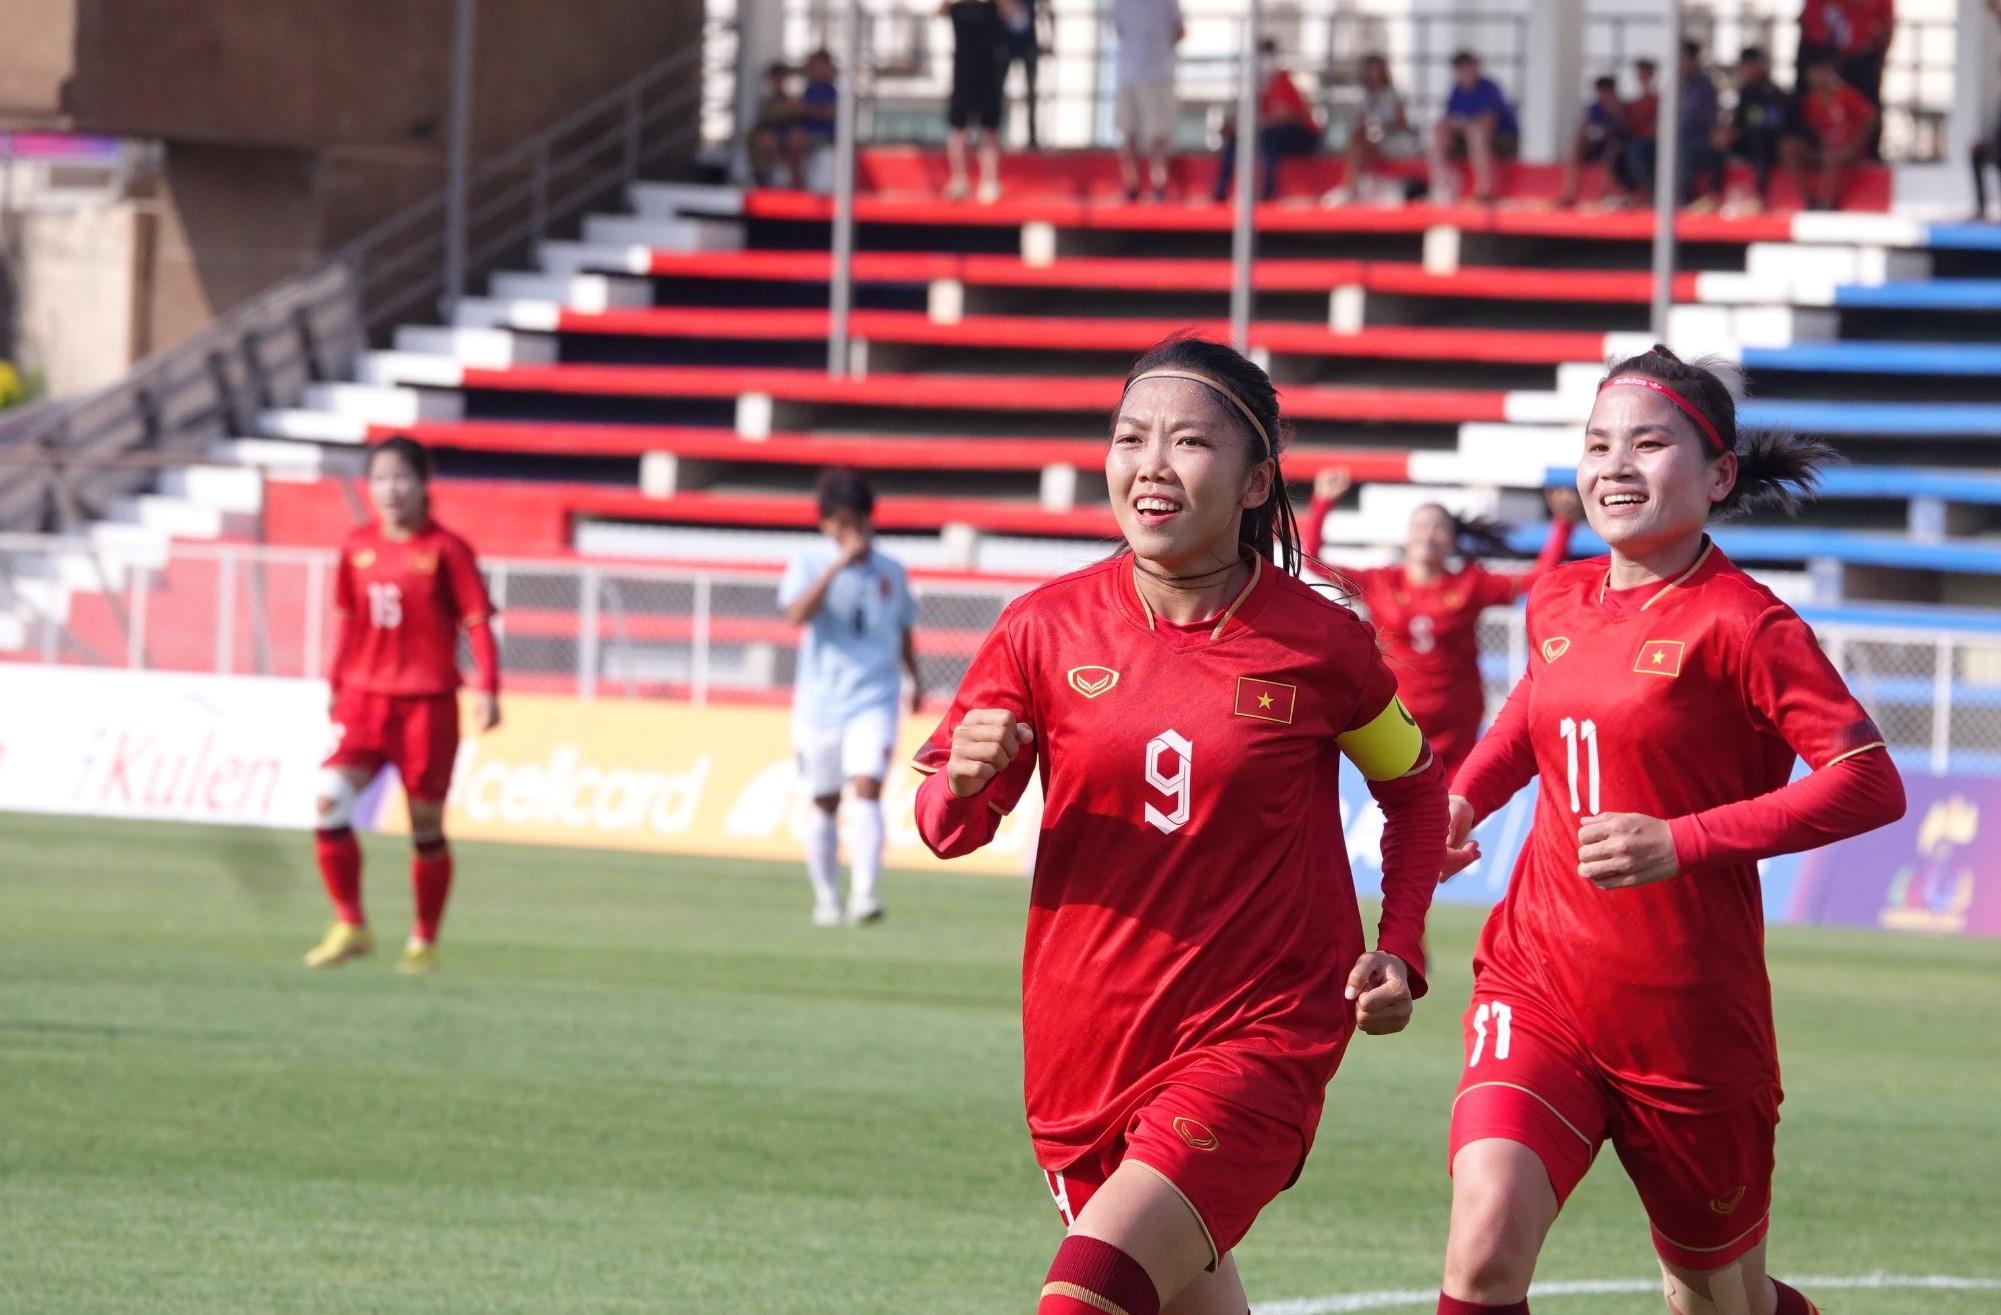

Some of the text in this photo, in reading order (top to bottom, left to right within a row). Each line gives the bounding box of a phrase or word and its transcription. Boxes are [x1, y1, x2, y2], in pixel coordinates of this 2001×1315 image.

[1613, 377, 1648, 387] adidas
[1144, 728, 1193, 835] 9
[1560, 716, 1600, 816] 11
